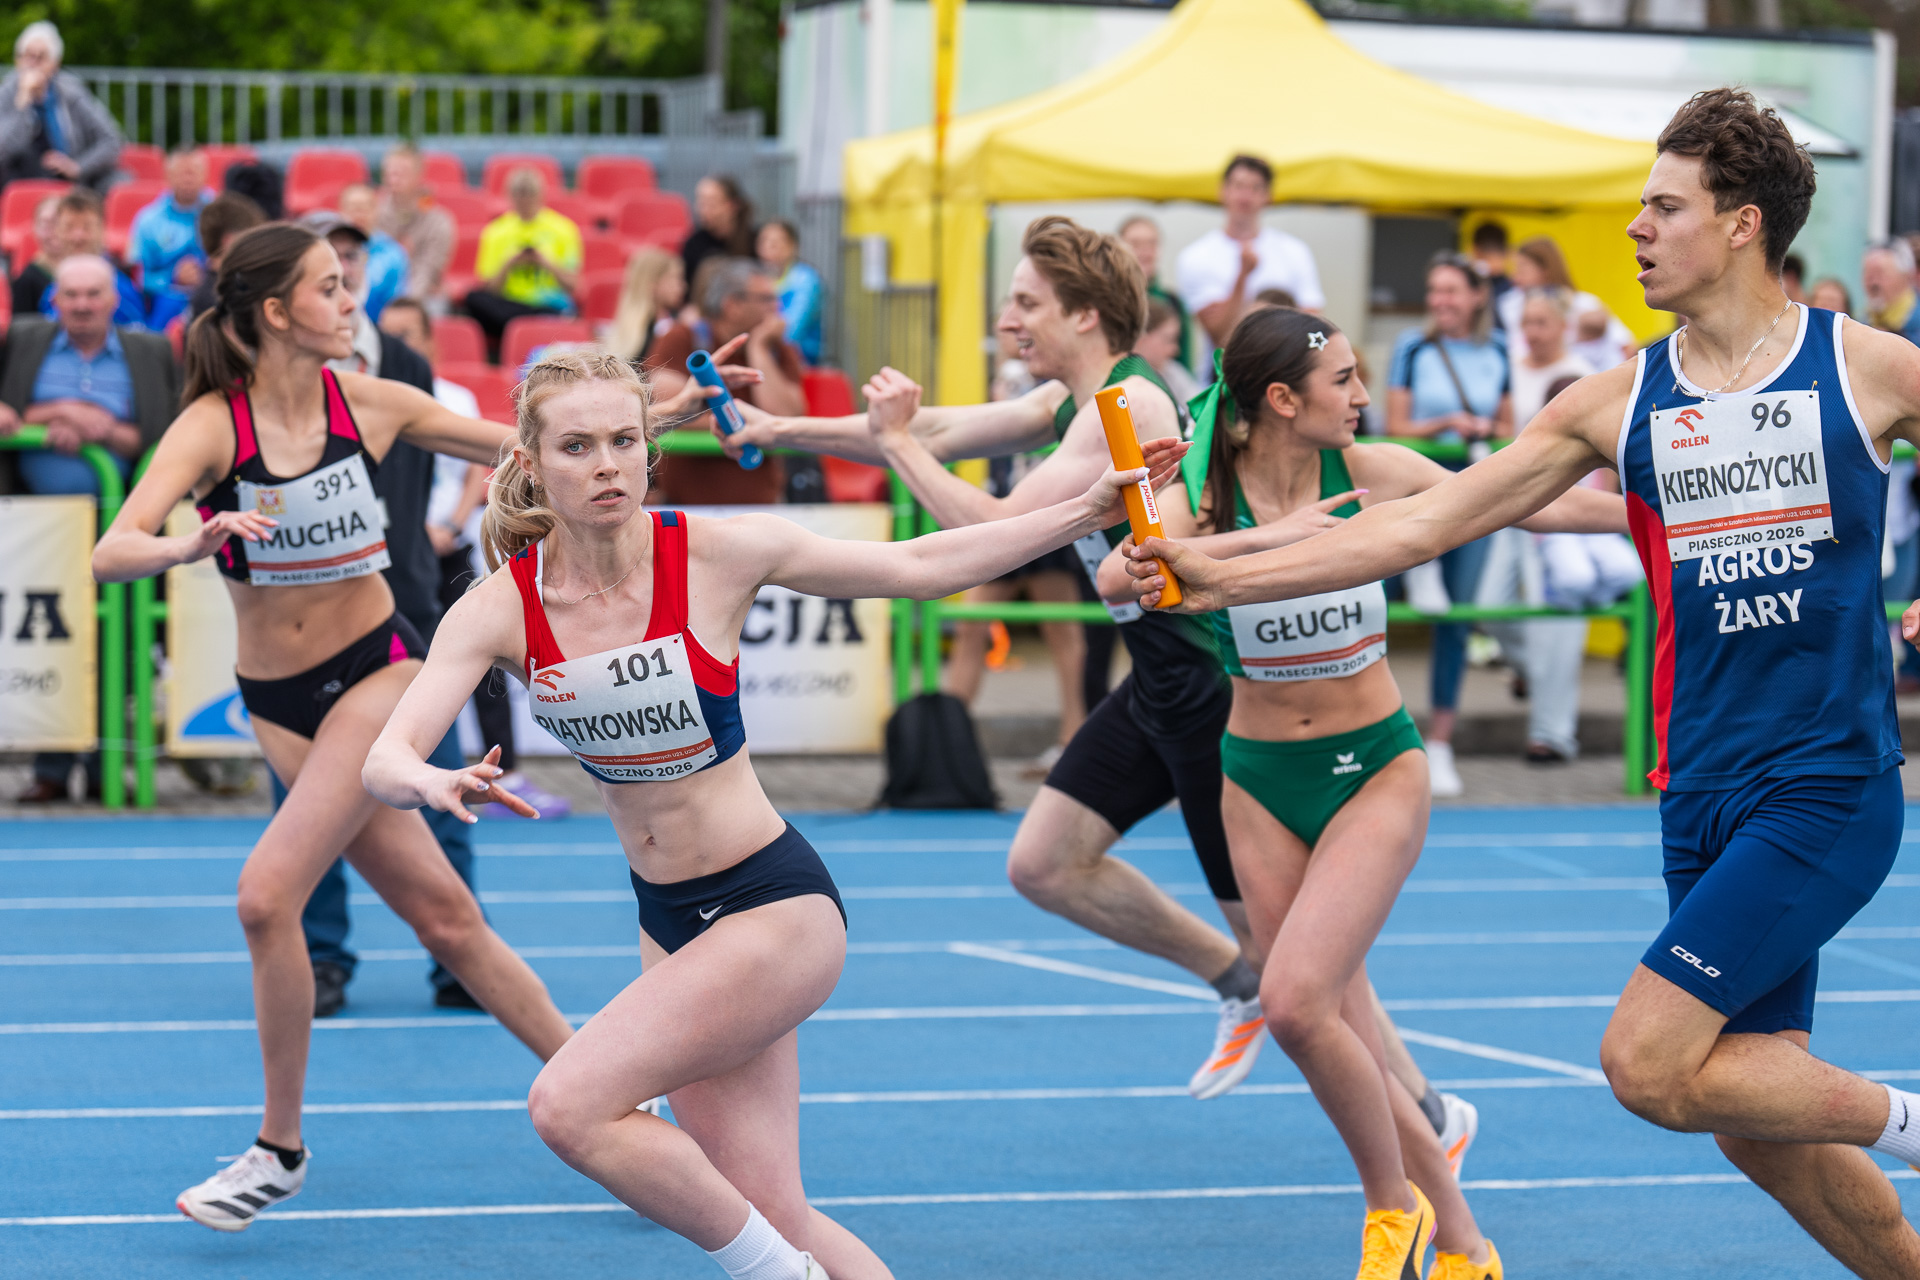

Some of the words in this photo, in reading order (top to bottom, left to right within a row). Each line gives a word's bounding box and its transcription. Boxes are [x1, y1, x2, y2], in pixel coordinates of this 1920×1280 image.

[1751, 400, 1792, 432] 96
[1671, 434, 1710, 450] ORLEN
[314, 468, 358, 501] 391
[1661, 450, 1818, 505] KIERNOŻYCKI
[1141, 484, 1157, 519] polanik
[256, 510, 368, 550] MUCHA
[1688, 531, 1763, 552] PIASECZNO
[1766, 526, 1805, 542] 2026
[1698, 542, 1815, 587] AGROS
[1255, 601, 1362, 644] GŁUCH
[1714, 588, 1803, 634] ŻARY
[607, 648, 673, 687] 101
[1264, 664, 1340, 678] PIASECZNO
[1342, 653, 1368, 672] 2026
[536, 692, 577, 703] ORLEN
[535, 700, 699, 746] PIĄTKOWSKA
[656, 761, 693, 777] 2026
[1669, 944, 1722, 978] COLO
